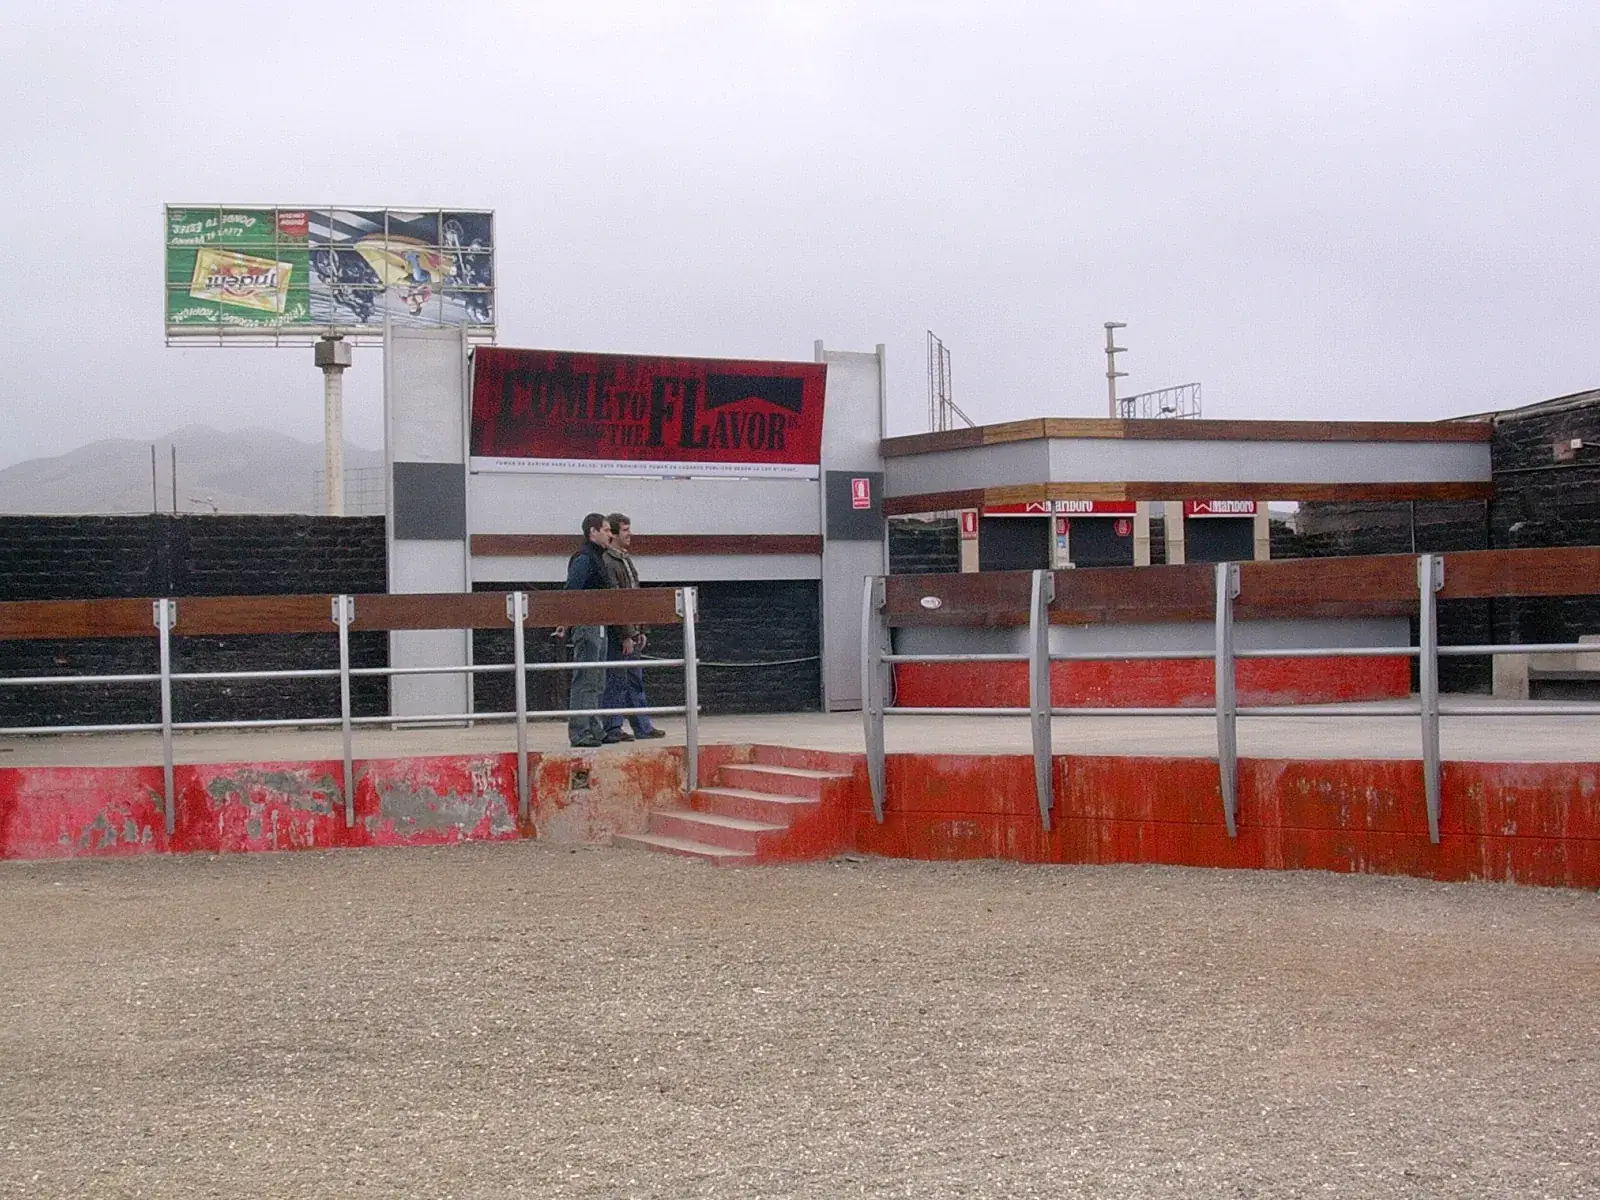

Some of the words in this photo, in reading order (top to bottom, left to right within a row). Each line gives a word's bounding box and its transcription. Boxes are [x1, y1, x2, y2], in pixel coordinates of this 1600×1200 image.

[499, 370, 615, 422] COME
[614, 392, 647, 421] TO
[647, 375, 787, 451] FLAVOR
